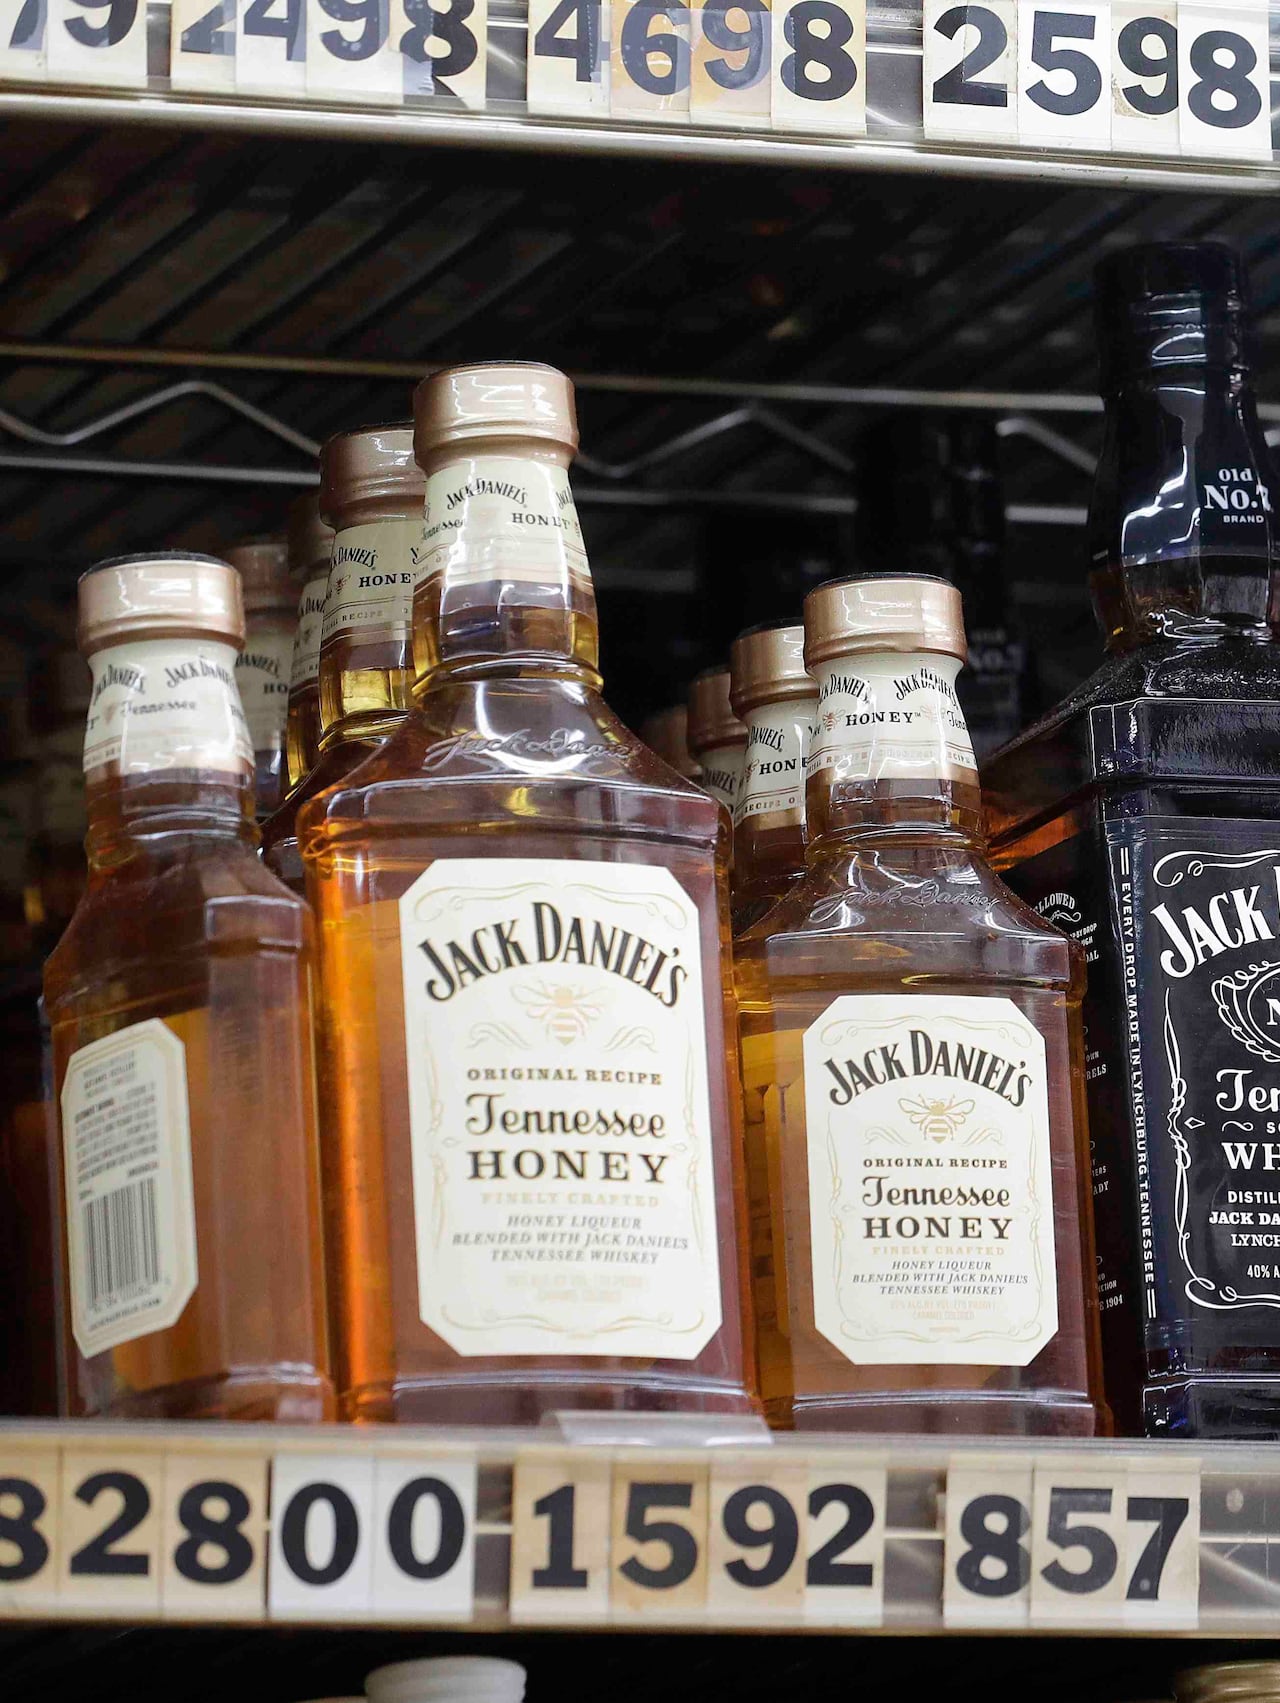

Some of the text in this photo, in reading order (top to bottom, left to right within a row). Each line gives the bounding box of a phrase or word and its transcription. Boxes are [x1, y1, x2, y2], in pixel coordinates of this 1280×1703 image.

[532, 0, 858, 102] 4698
[931, 4, 1262, 130] 2598
[1218, 468, 1253, 482] Old
[1223, 515, 1265, 524] BRAND
[893, 674, 920, 701] JACK
[846, 711, 914, 727] HONEY
[1150, 885, 1275, 978] JACK
[418, 902, 689, 1008] JACK DANIEL'S
[466, 1068, 662, 1085] ORIGINAL RECIPE
[824, 1030, 1033, 1108] JACK DANIEL'S
[1121, 881, 1155, 1284] EVERY DROP MADE IN LYNCHBURG TENNESSEE
[465, 1093, 666, 1139] Tennessee
[467, 1149, 669, 1183] HONEY
[863, 1158, 1008, 1169] ORIGINAL RECIPE
[862, 1176, 1010, 1207] Tennessee
[507, 1215, 643, 1230] HONEY LIQUEUR
[1209, 1211, 1255, 1225] JACK
[862, 1217, 1013, 1240] HONEY
[452, 1233, 689, 1250] BLENDED WITH JACK DANIEL'S
[491, 1250, 660, 1265] TENNESSEE WHISKEY
[872, 1247, 1005, 1256] FINELY CRAFTED
[892, 1261, 992, 1272] HONEY LIQUEUR
[1247, 1264, 1270, 1279] 40%
[852, 1274, 1029, 1284] BLENDED WITH JACK DANIEL'S
[880, 1286, 1006, 1296] TENNESSEE WHISKEY
[1105, 1294, 1123, 1309] 1904
[531, 1483, 875, 1590] 1592
[955, 1487, 1190, 1600] 857
